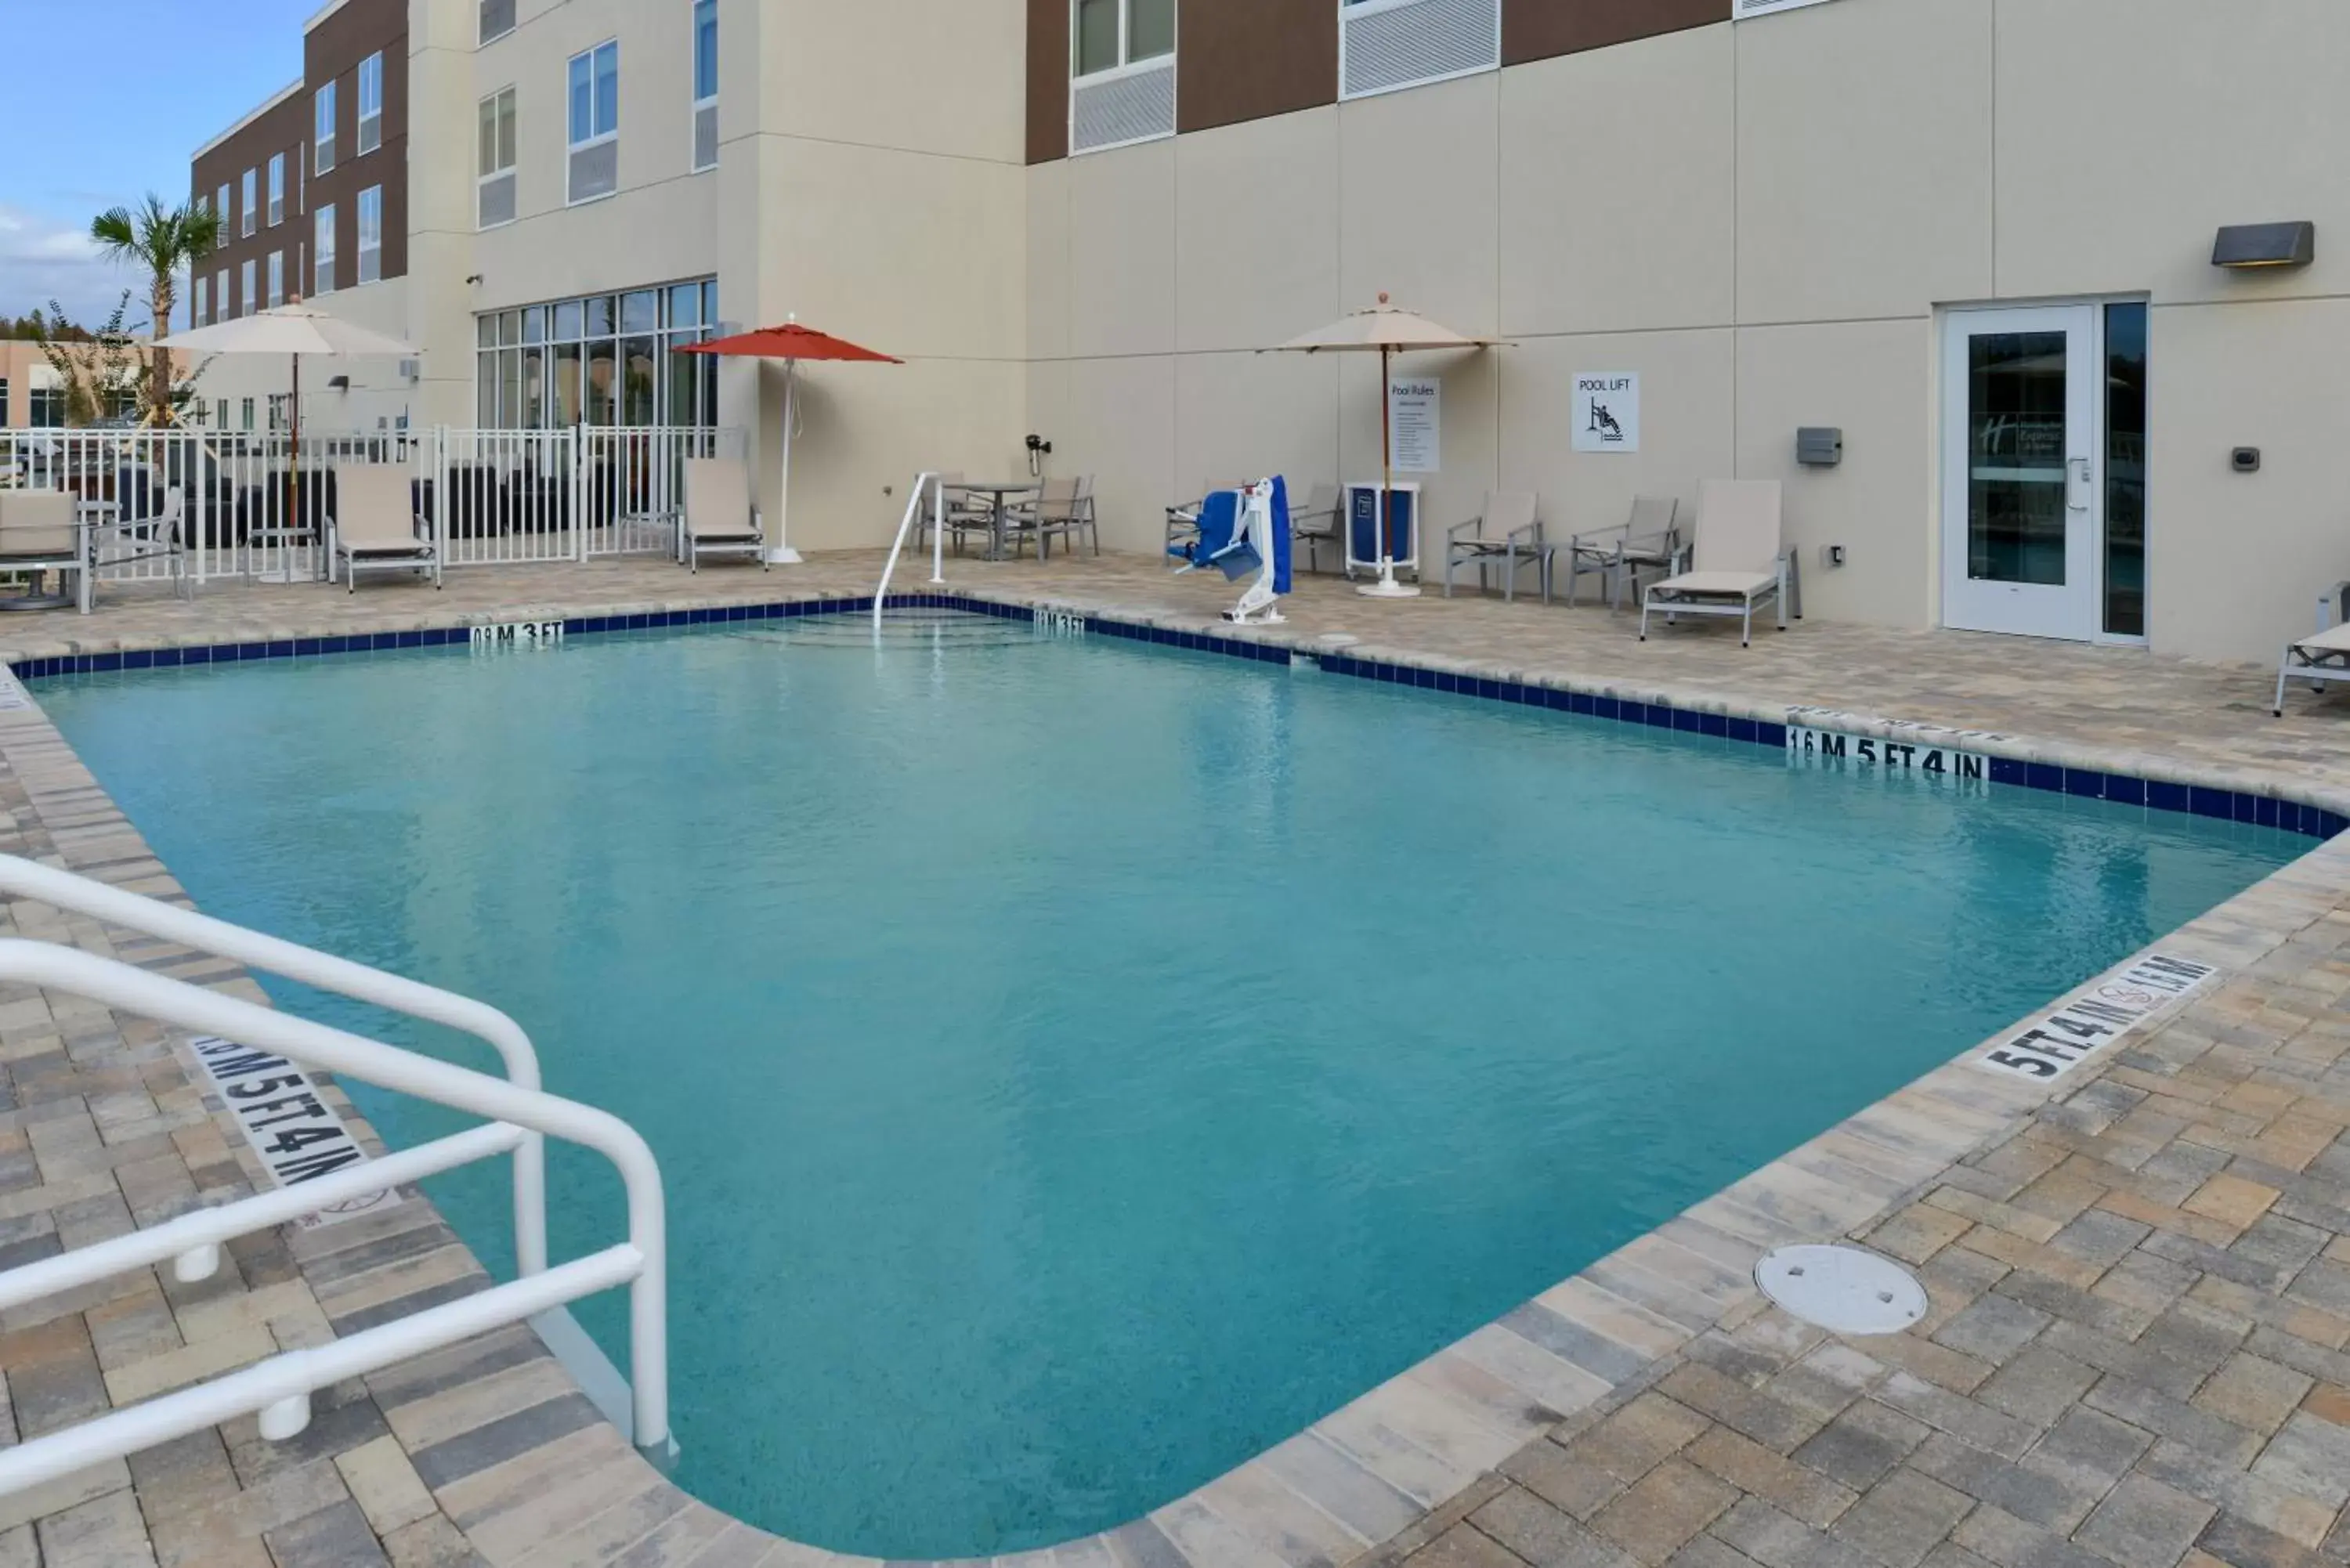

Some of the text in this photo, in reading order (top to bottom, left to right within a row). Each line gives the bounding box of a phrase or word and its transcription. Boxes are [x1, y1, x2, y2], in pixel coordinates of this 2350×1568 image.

[1392, 384, 1434, 396] Pool Rules
[1579, 378, 1630, 391] POOL LIFT
[497, 625, 515, 640] M
[522, 623, 537, 637] 3
[542, 621, 562, 636] FT
[1821, 733, 1846, 757] M
[1857, 739, 1876, 761] 5
[1885, 744, 1915, 768] FT
[1922, 750, 1946, 773] 4
[1954, 753, 1982, 779] IN
[1987, 1051, 2058, 1077] 5
[2048, 1016, 2115, 1038] 4
[208, 1052, 290, 1079] M
[226, 1074, 304, 1098] 5
[265, 1126, 344, 1154] 4
